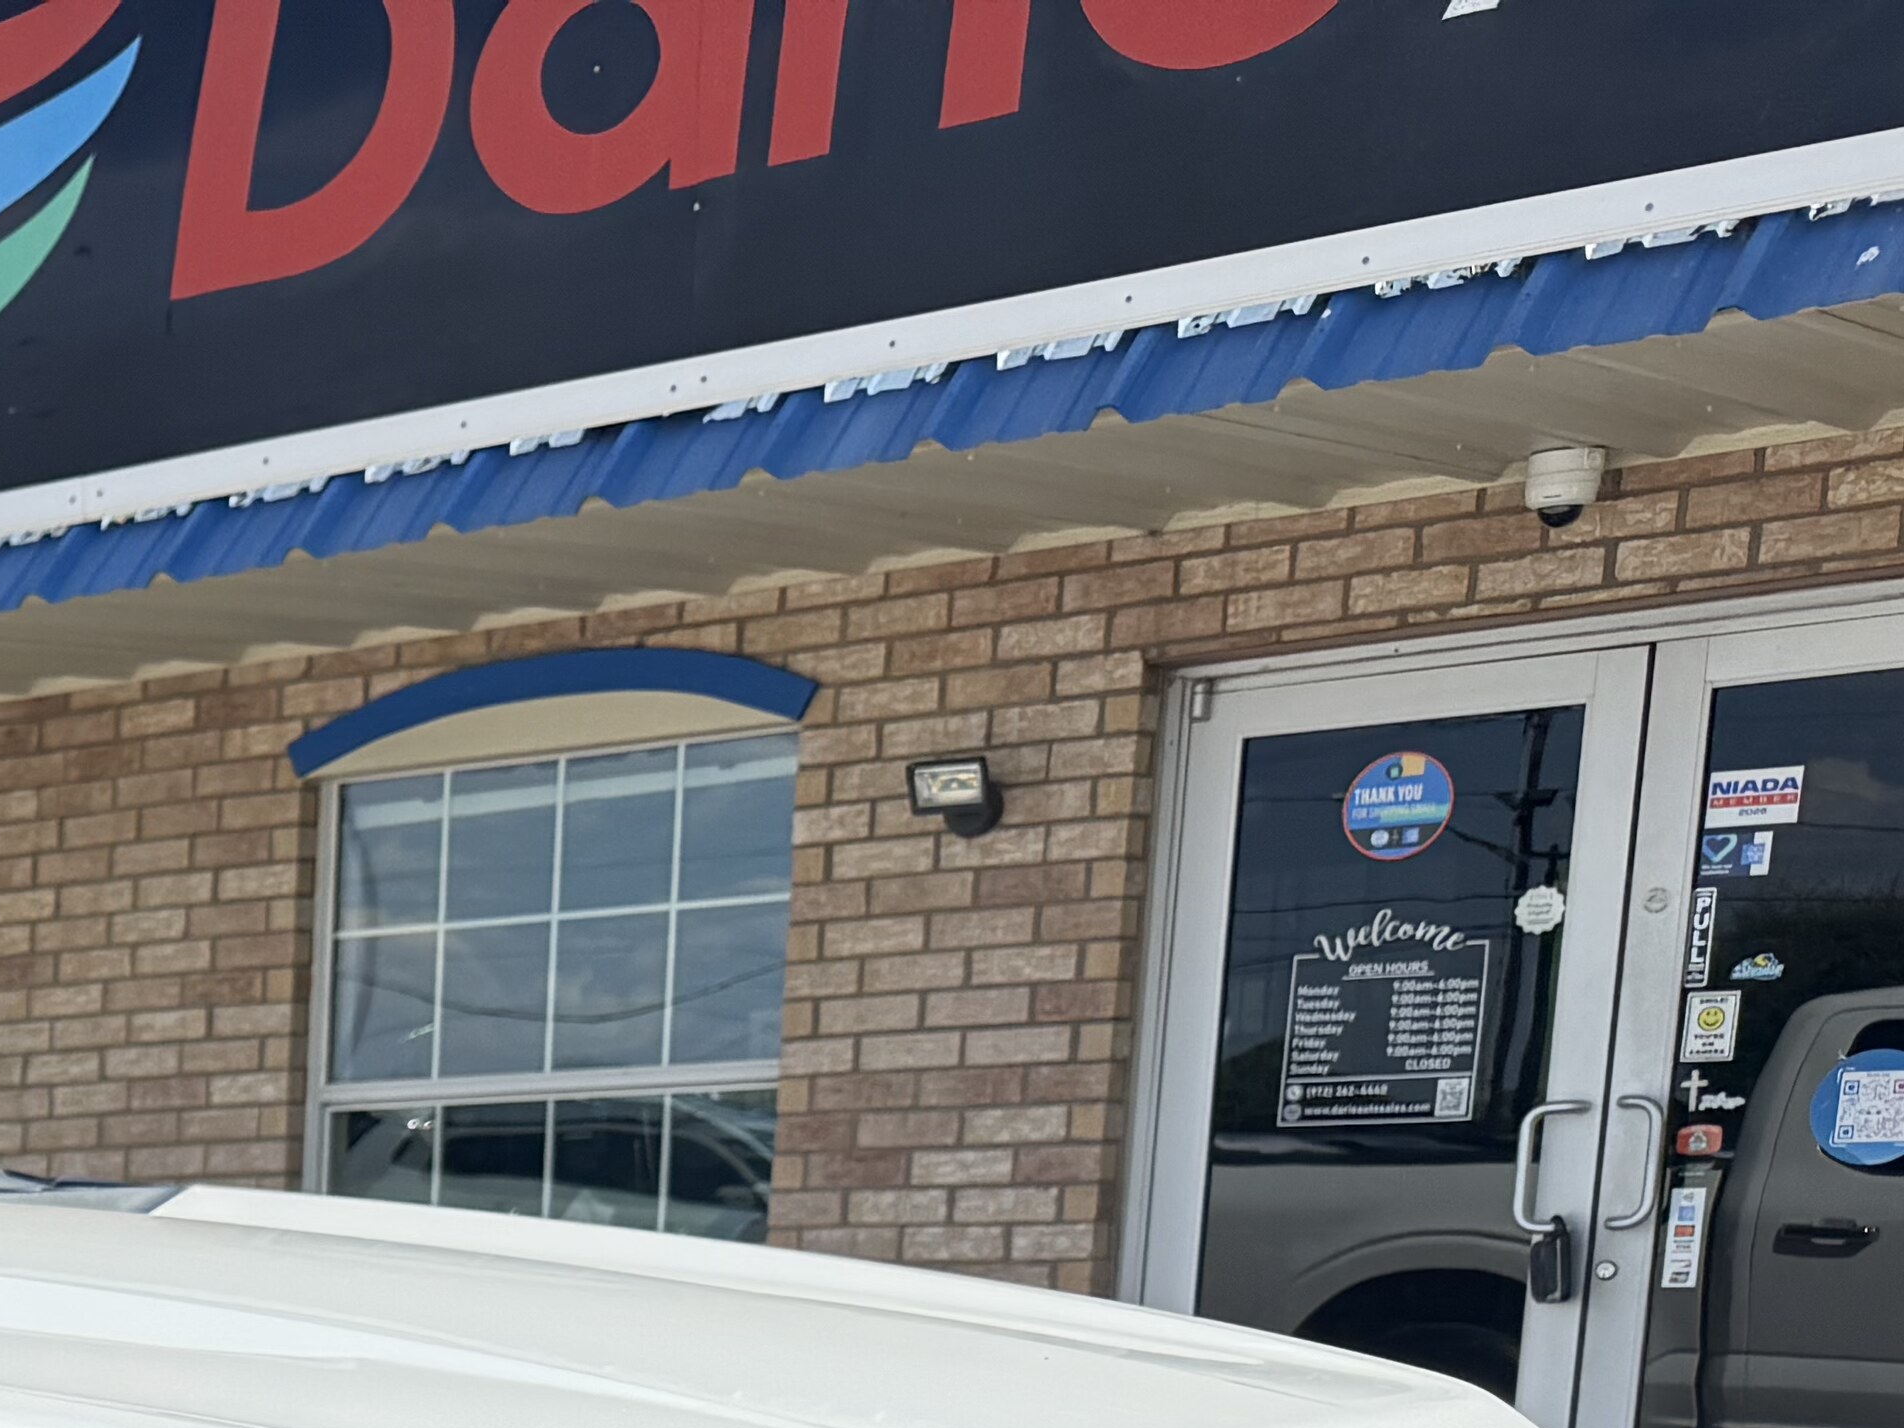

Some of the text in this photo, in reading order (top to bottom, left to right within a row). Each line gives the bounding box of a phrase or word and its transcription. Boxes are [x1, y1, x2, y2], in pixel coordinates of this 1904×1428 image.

[1711, 776, 1800, 796] NIADA
[1354, 783, 1424, 805] THANK YOU
[1712, 794, 1796, 806] MEMBER
[1313, 908, 1467, 961] Welcome
[1691, 896, 1712, 964] PULL
[1348, 961, 1430, 976] OPEN HOURS
[1297, 986, 1340, 997] Monday
[1297, 999, 1340, 1010] Tuesday
[1295, 1011, 1356, 1023] Wednesday
[1294, 1025, 1344, 1036] Thursday
[1292, 1038, 1326, 1049] Friday
[1291, 1051, 1340, 1062] Saturday
[1289, 1057, 1451, 1075] Sunday CLOSED
